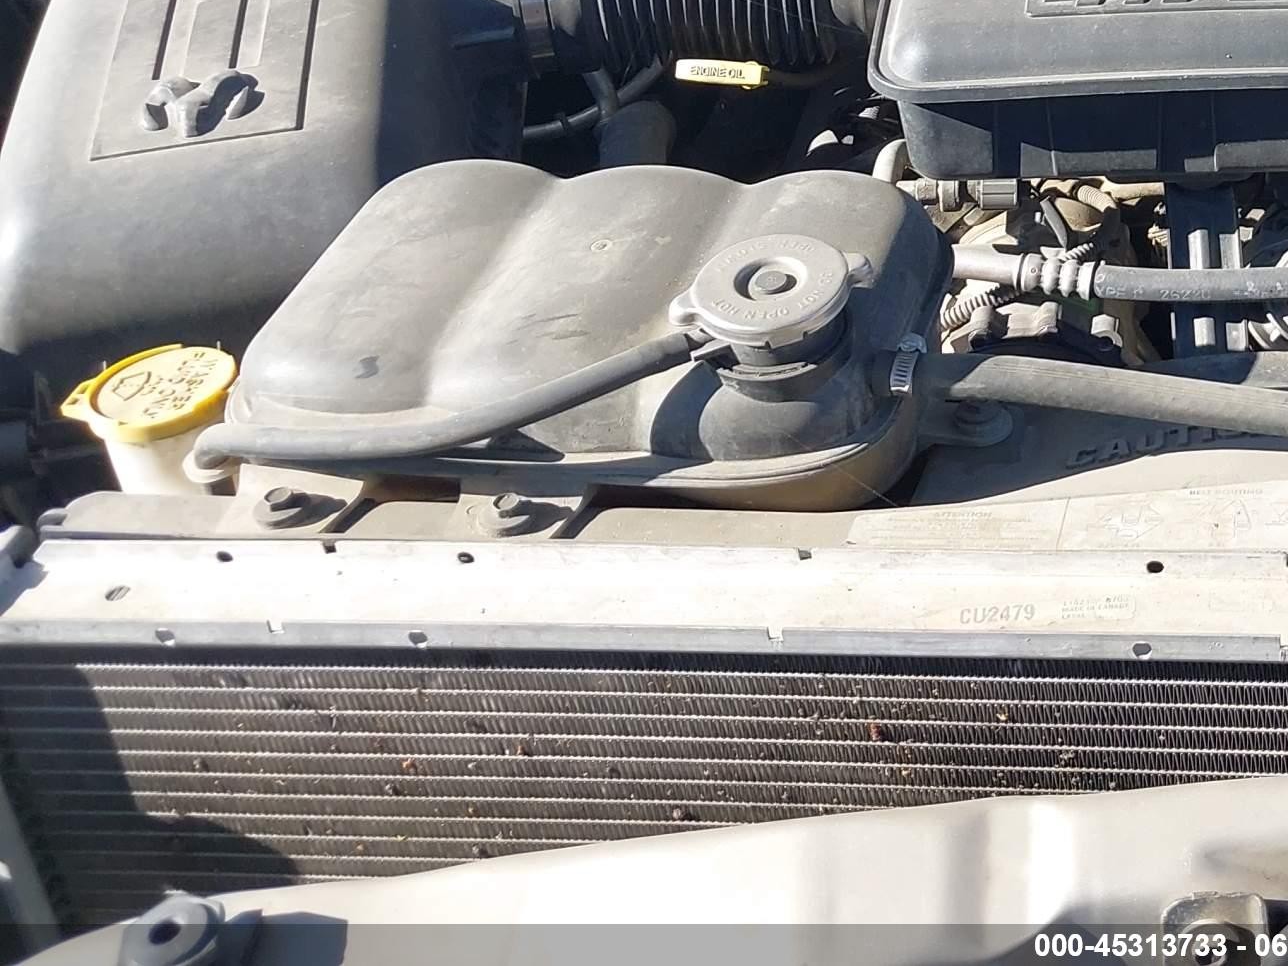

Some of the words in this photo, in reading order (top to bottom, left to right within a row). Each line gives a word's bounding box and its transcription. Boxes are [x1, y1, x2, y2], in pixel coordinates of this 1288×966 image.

[690, 65, 727, 78] ENGINE
[728, 68, 746, 80] OIL
[958, 602, 1037, 626] CU2479
